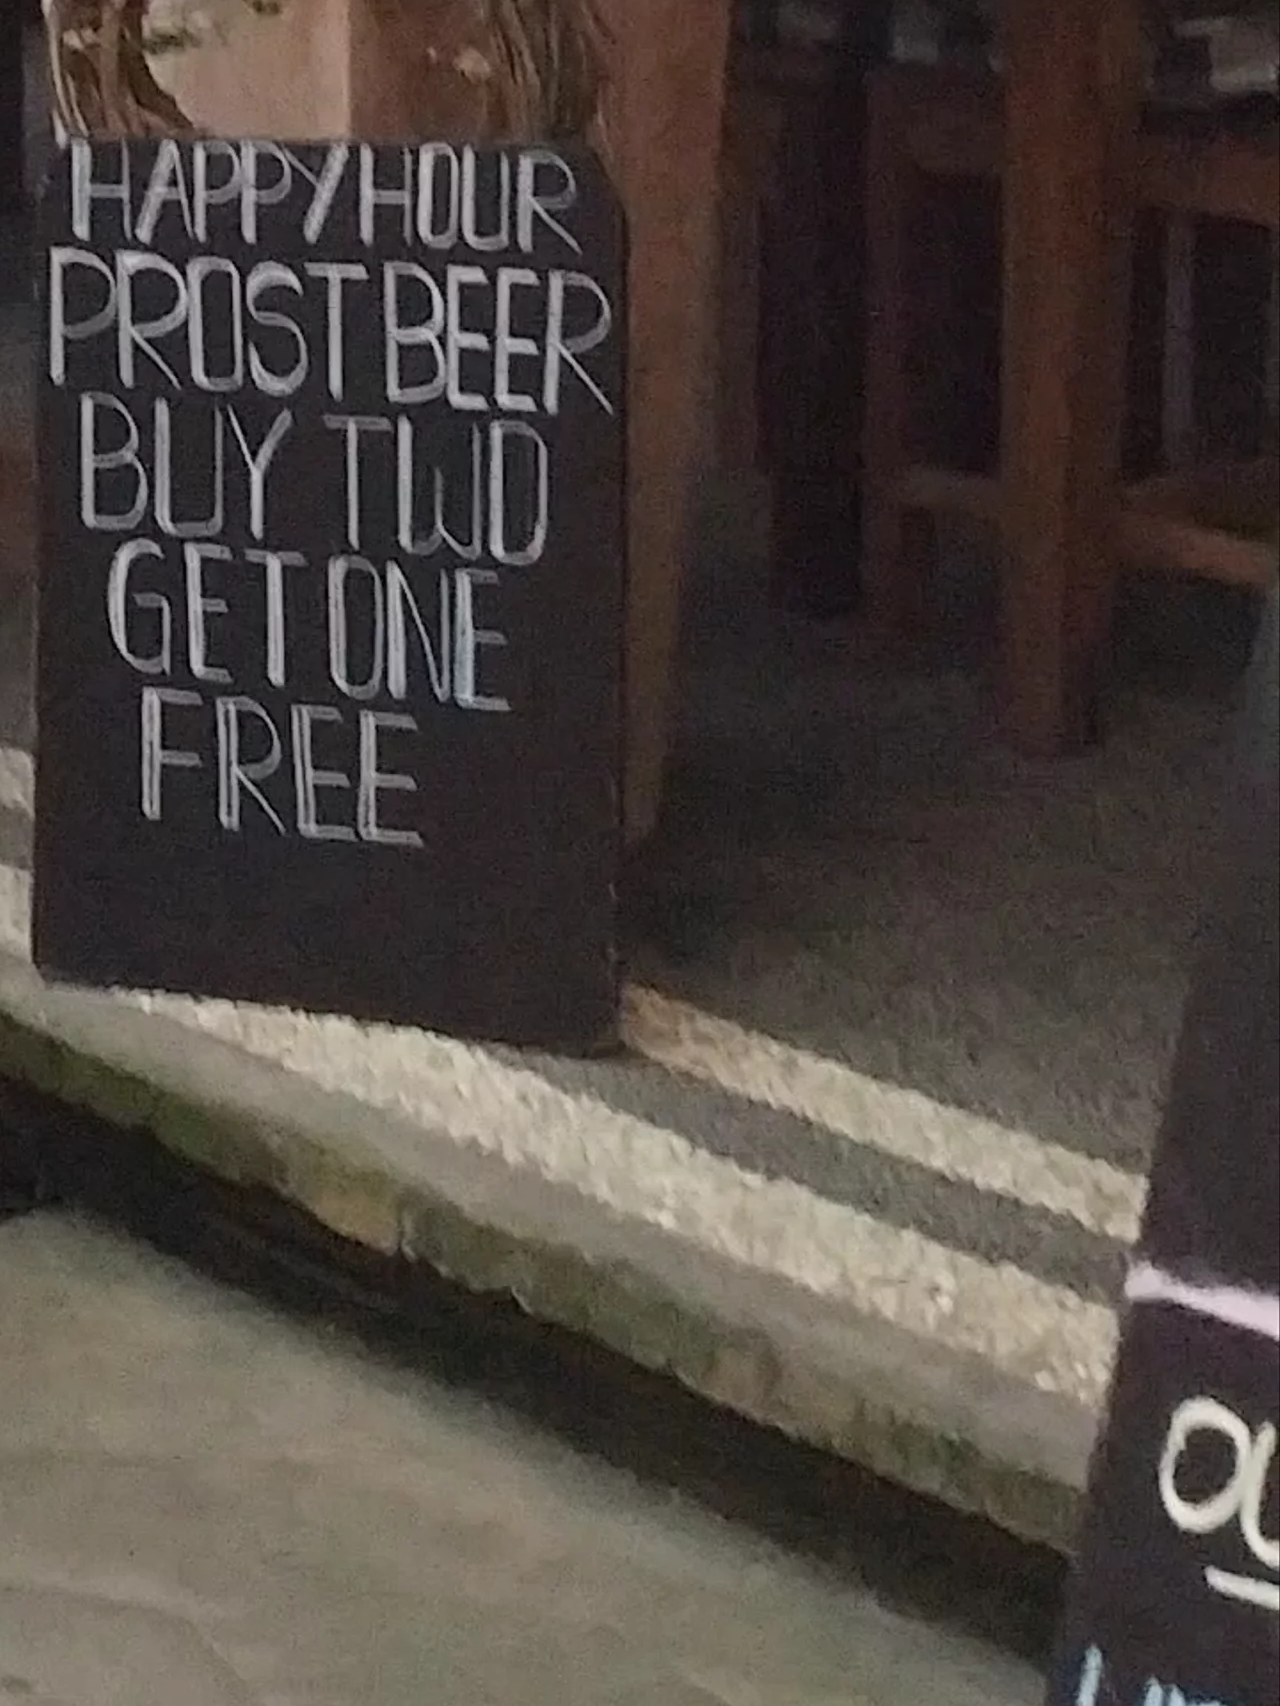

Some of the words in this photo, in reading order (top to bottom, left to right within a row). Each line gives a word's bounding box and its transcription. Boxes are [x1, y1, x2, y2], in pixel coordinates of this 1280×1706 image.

[71, 141, 350, 246] HAPPY
[358, 141, 582, 255] HOUR
[49, 245, 370, 402] PROST
[382, 261, 614, 415] BEER
[80, 391, 295, 539] BUY
[322, 414, 549, 567] TWO
[106, 539, 308, 687] GET
[327, 553, 513, 712] ONE
[141, 687, 425, 847] FREE
